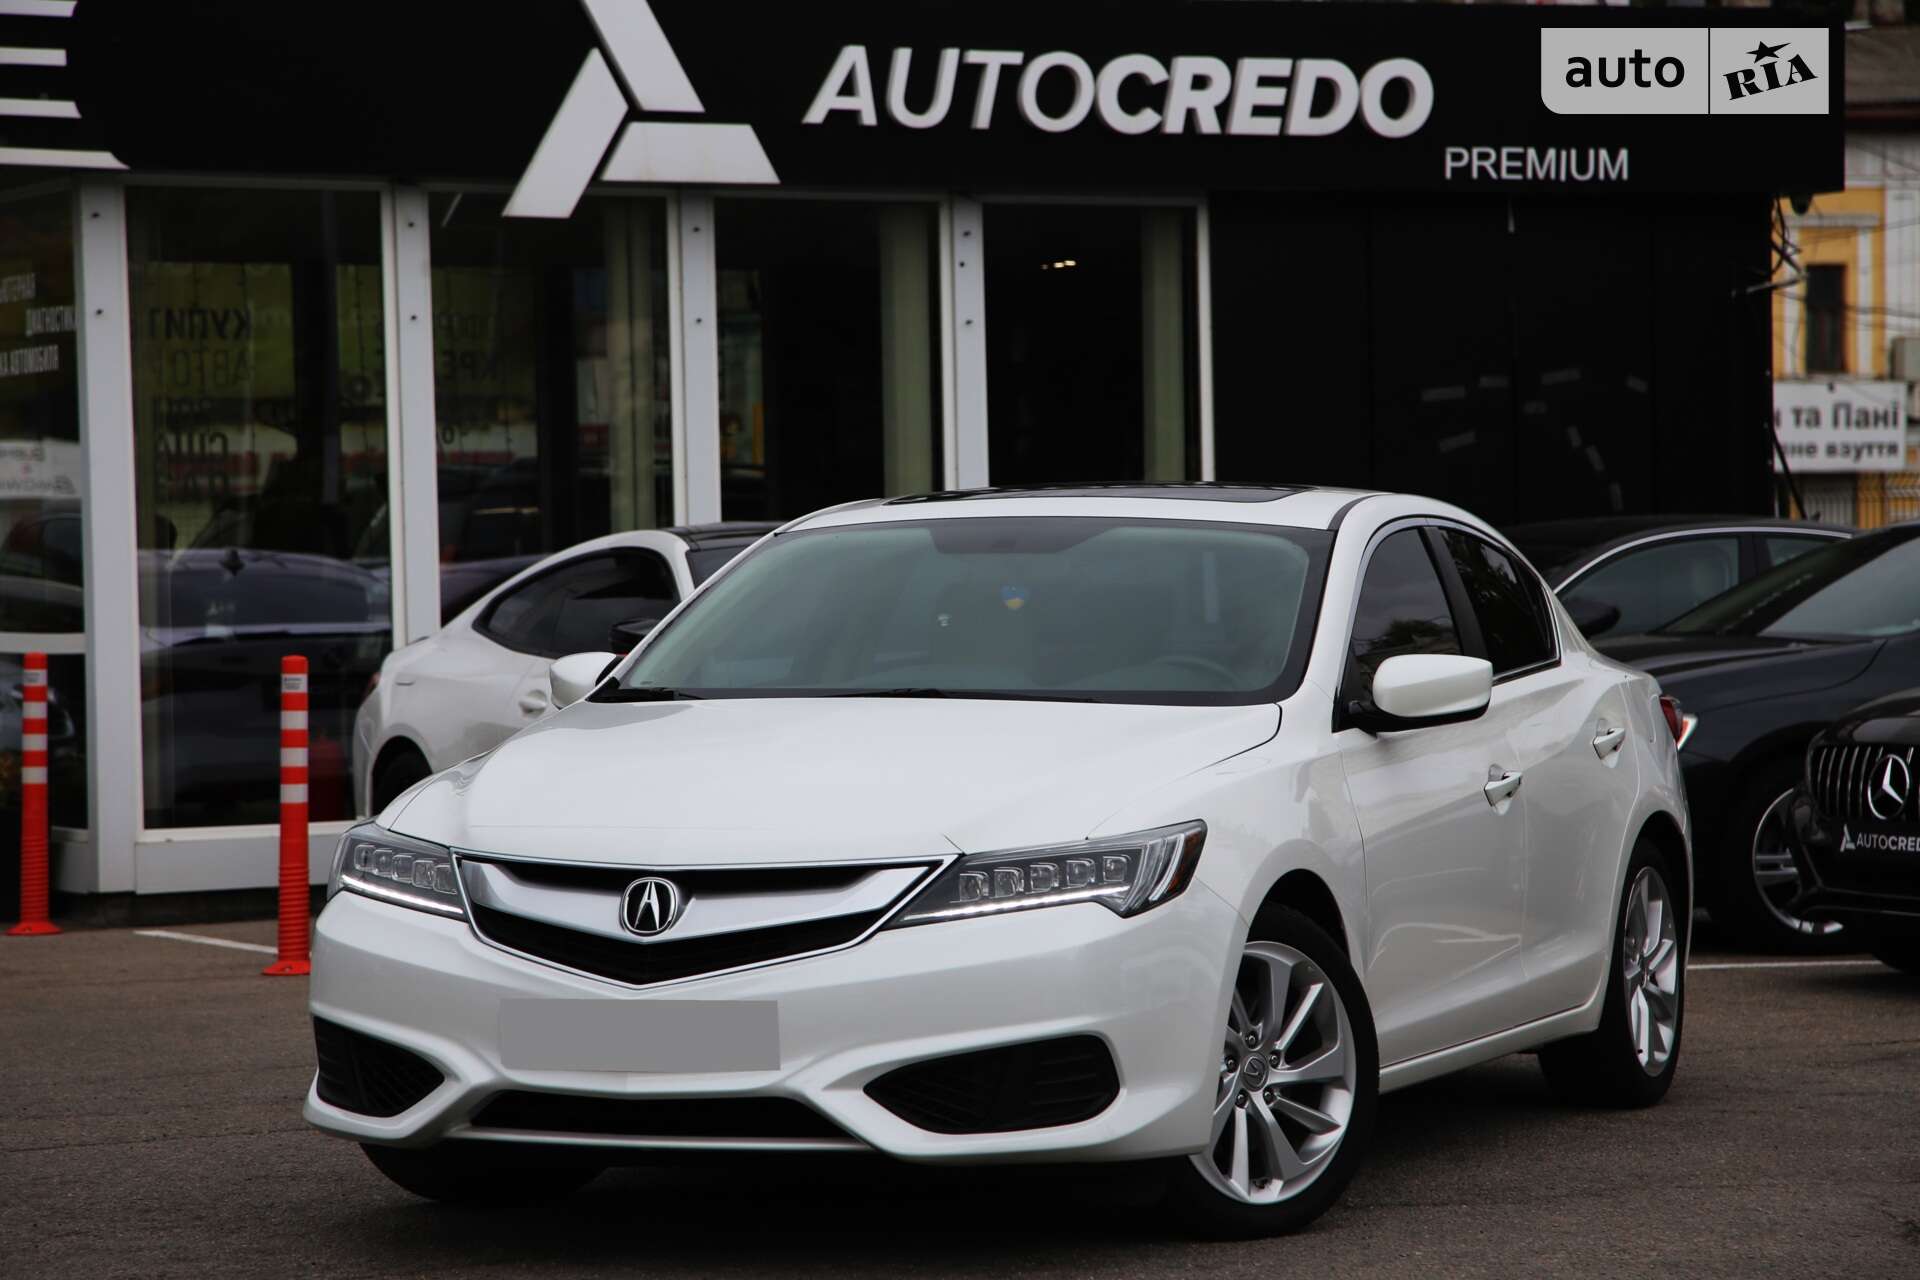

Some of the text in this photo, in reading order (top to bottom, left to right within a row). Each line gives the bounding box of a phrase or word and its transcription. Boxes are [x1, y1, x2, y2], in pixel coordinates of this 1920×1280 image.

[801, 45, 1434, 138] AUTOCREDO
[1445, 147, 1628, 182] PREMIUM
[1792, 405, 1821, 429] та
[1832, 401, 1899, 430] Пані
[1826, 442, 1899, 463] взуття
